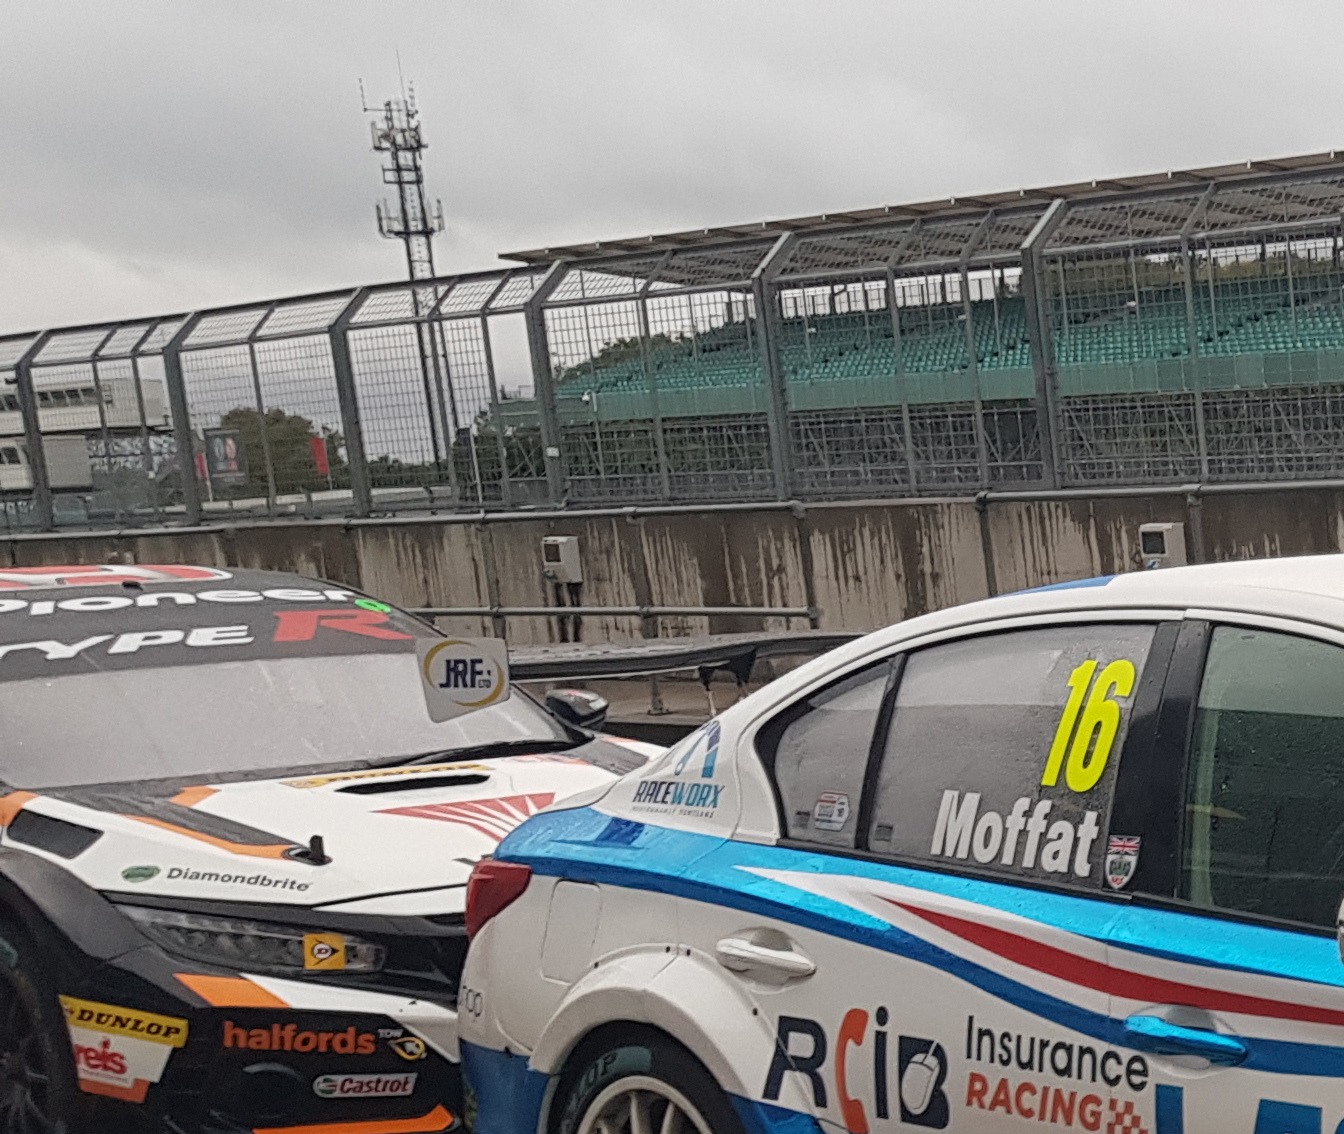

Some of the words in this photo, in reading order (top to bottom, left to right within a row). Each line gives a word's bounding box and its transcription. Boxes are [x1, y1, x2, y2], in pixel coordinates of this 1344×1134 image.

[273, 609, 415, 642] R
[439, 658, 484, 689] JRF
[1041, 659, 1135, 793] 16
[632, 780, 726, 808] RACEWORX
[930, 789, 1100, 878] Moffat
[166, 867, 311, 892] Diamondbrite
[76, 1008, 182, 1039] DUNLOP
[223, 1020, 378, 1055] halfords
[965, 1014, 1150, 1092] Insurance
[339, 1075, 413, 1095] Castrol
[965, 1071, 1102, 1134] RACING
